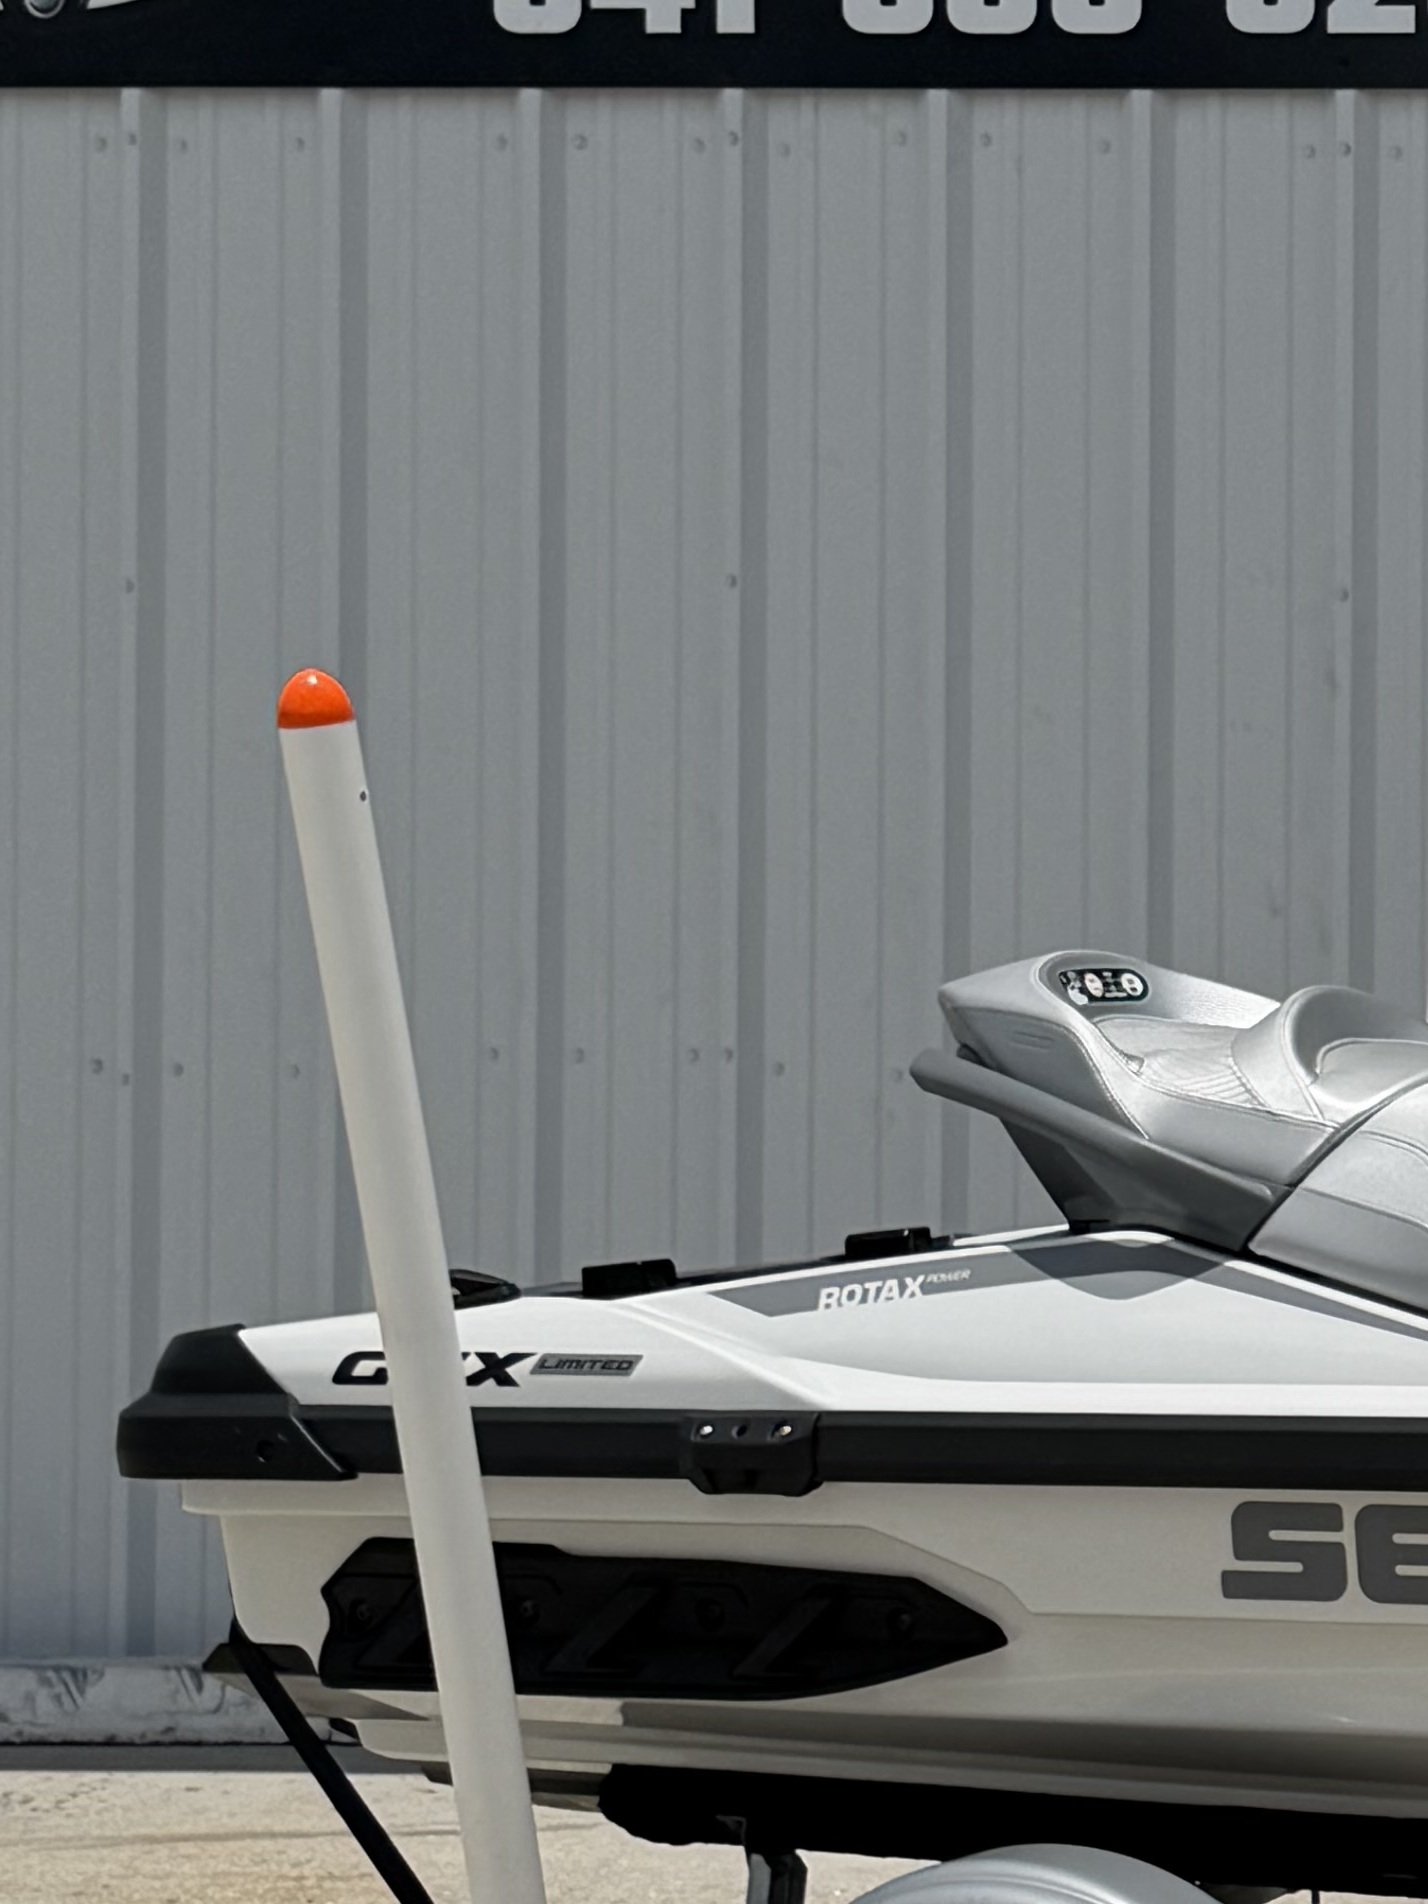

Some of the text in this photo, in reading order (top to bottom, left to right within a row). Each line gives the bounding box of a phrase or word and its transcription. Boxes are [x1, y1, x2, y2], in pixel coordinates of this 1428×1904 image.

[818, 1274, 926, 1311] ROTAX
[332, 1351, 634, 1387] GX LIMITED
